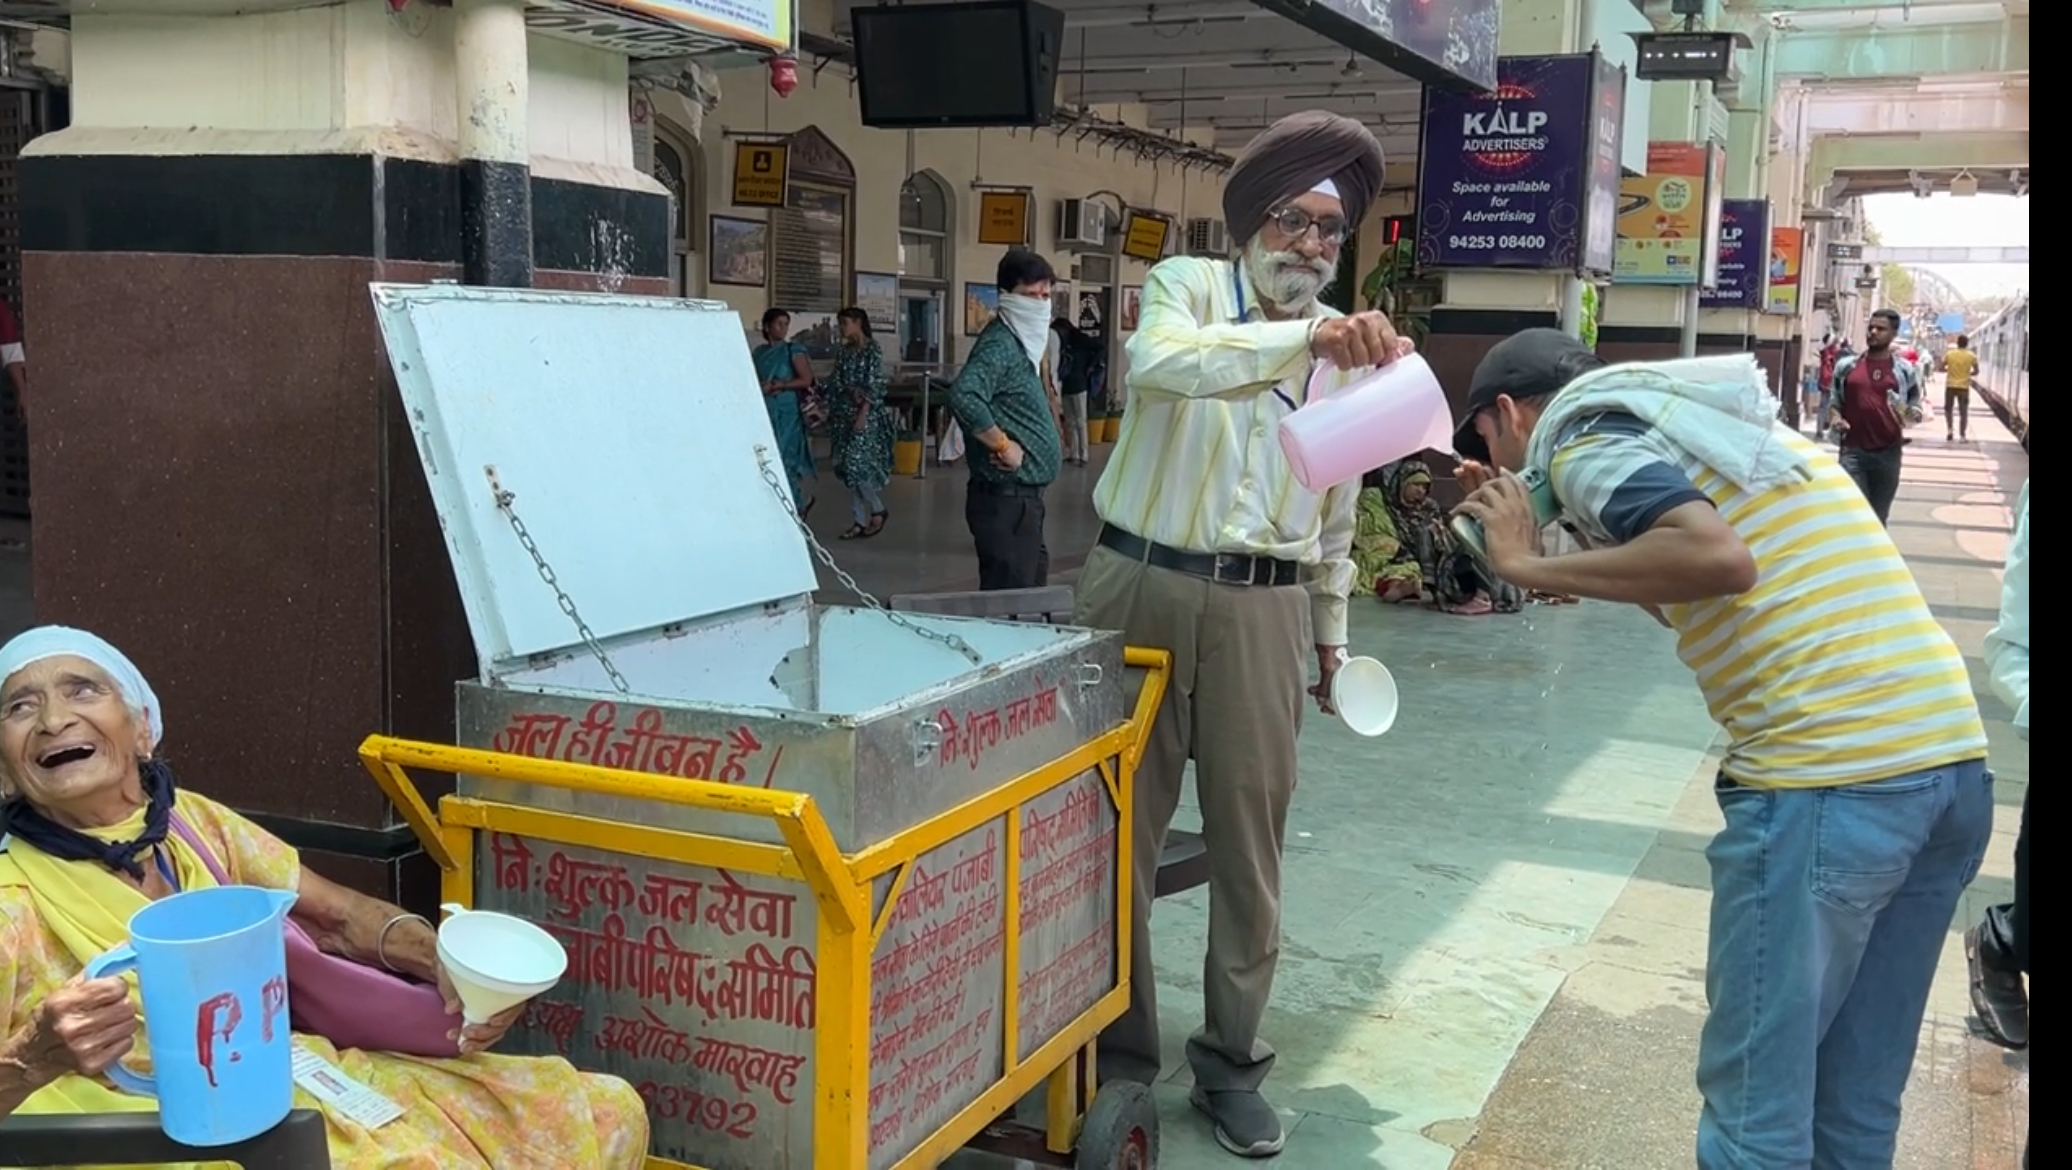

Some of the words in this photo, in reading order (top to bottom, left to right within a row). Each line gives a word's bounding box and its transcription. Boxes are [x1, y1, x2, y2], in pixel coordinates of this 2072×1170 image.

[1463, 104, 1547, 135] KALP
[1462, 137, 1546, 151] ADVERTISERS
[1452, 181, 1491, 194] Space
[1493, 180, 1551, 193] available
[1491, 197, 1510, 207] for
[1462, 211, 1536, 224] Advertising
[1450, 235, 1495, 248] 94253
[1499, 235, 1546, 248] 08400
[1004, 697, 1031, 740] जल
[1034, 675, 1058, 729] सेवा
[493, 714, 572, 760] जल
[565, 701, 616, 766] ही
[606, 708, 723, 781] जीवन
[719, 725, 763, 783] है
[638, 874, 702, 925] जल
[705, 867, 797, 939] सेवा
[716, 943, 816, 1029] समिति
[594, 1005, 691, 1064] अशोक
